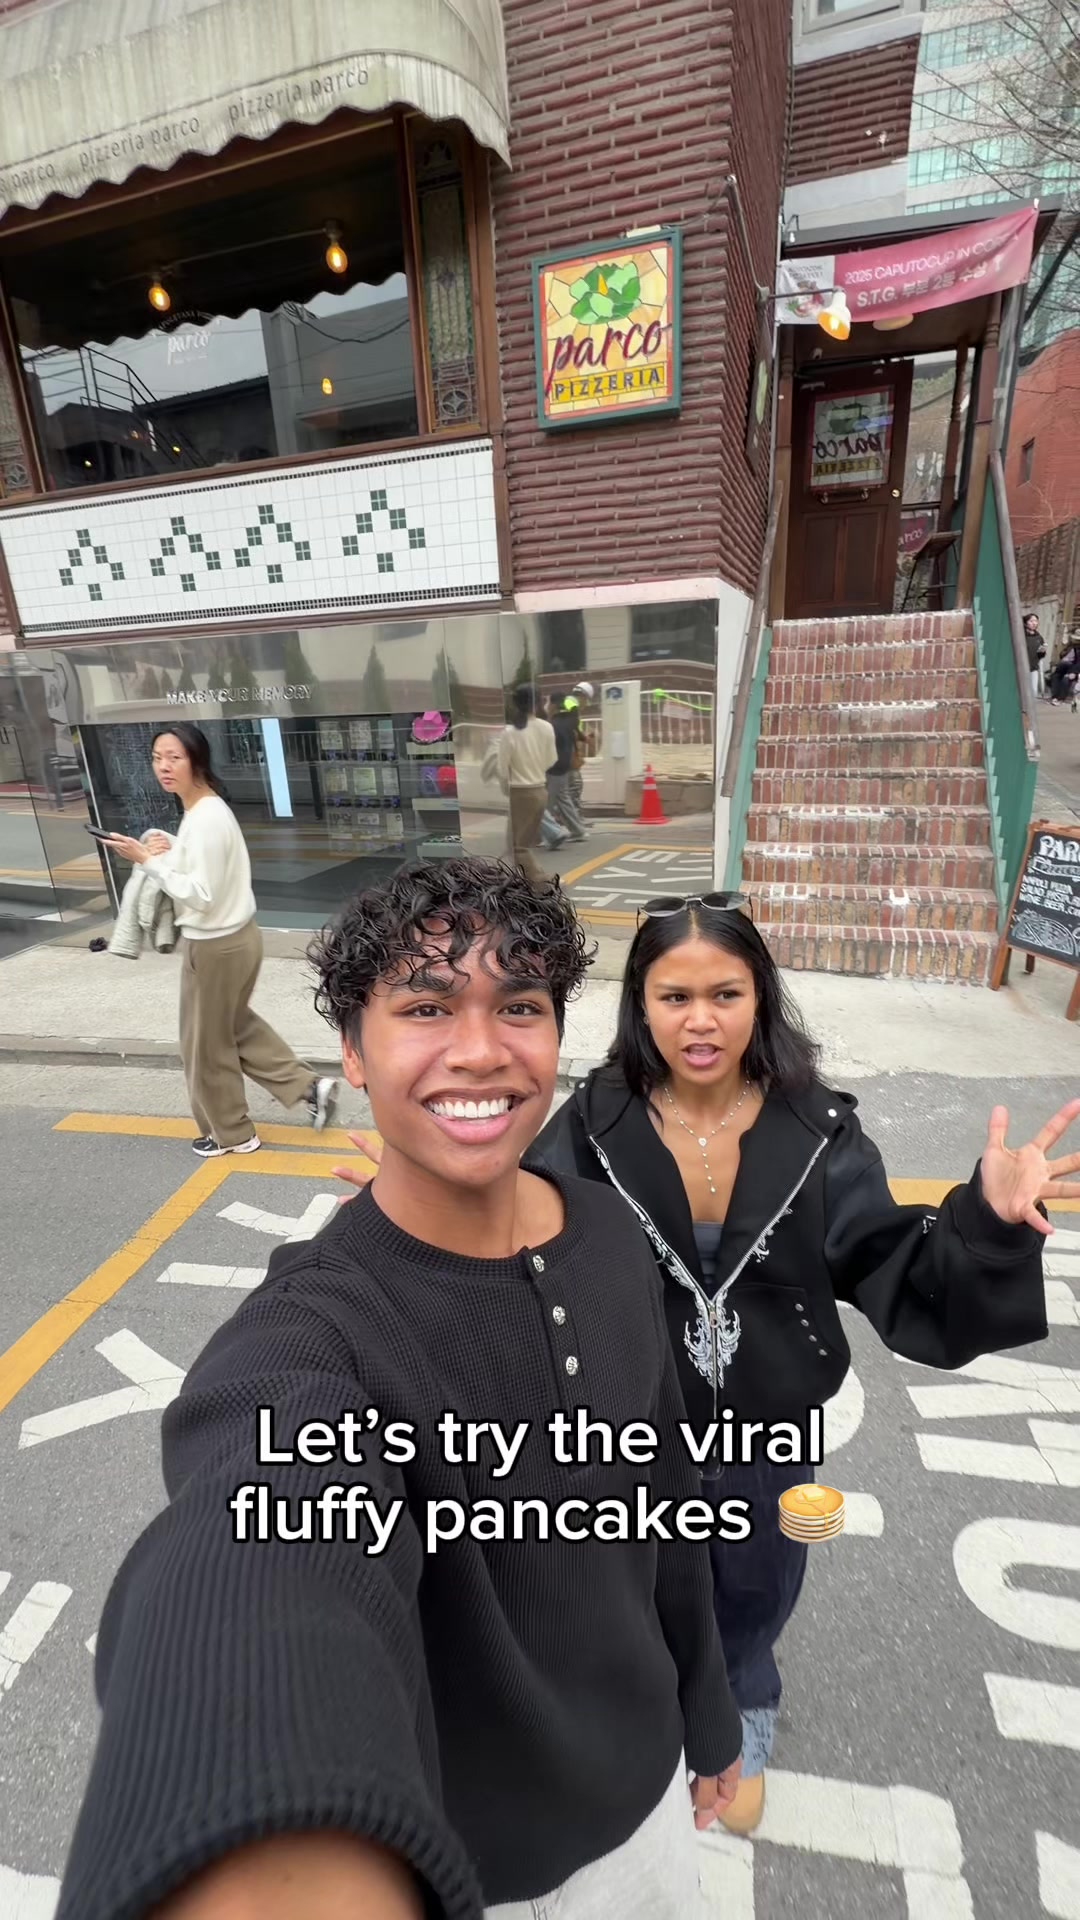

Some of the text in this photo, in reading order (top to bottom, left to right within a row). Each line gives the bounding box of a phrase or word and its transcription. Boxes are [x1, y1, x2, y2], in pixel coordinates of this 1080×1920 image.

[228, 69, 369, 124] pizzeria parco
[79, 117, 200, 169] pizzeria parco
[10, 163, 55, 192] parco
[856, 286, 897, 308] S.T.G.
[545, 320, 672, 397] parco
[555, 368, 661, 399] PIZZERIA
[898, 528, 923, 546] arco
[166, 684, 312, 705] MAKE YOUR MEMORY
[1039, 836, 1080, 862] PAR
